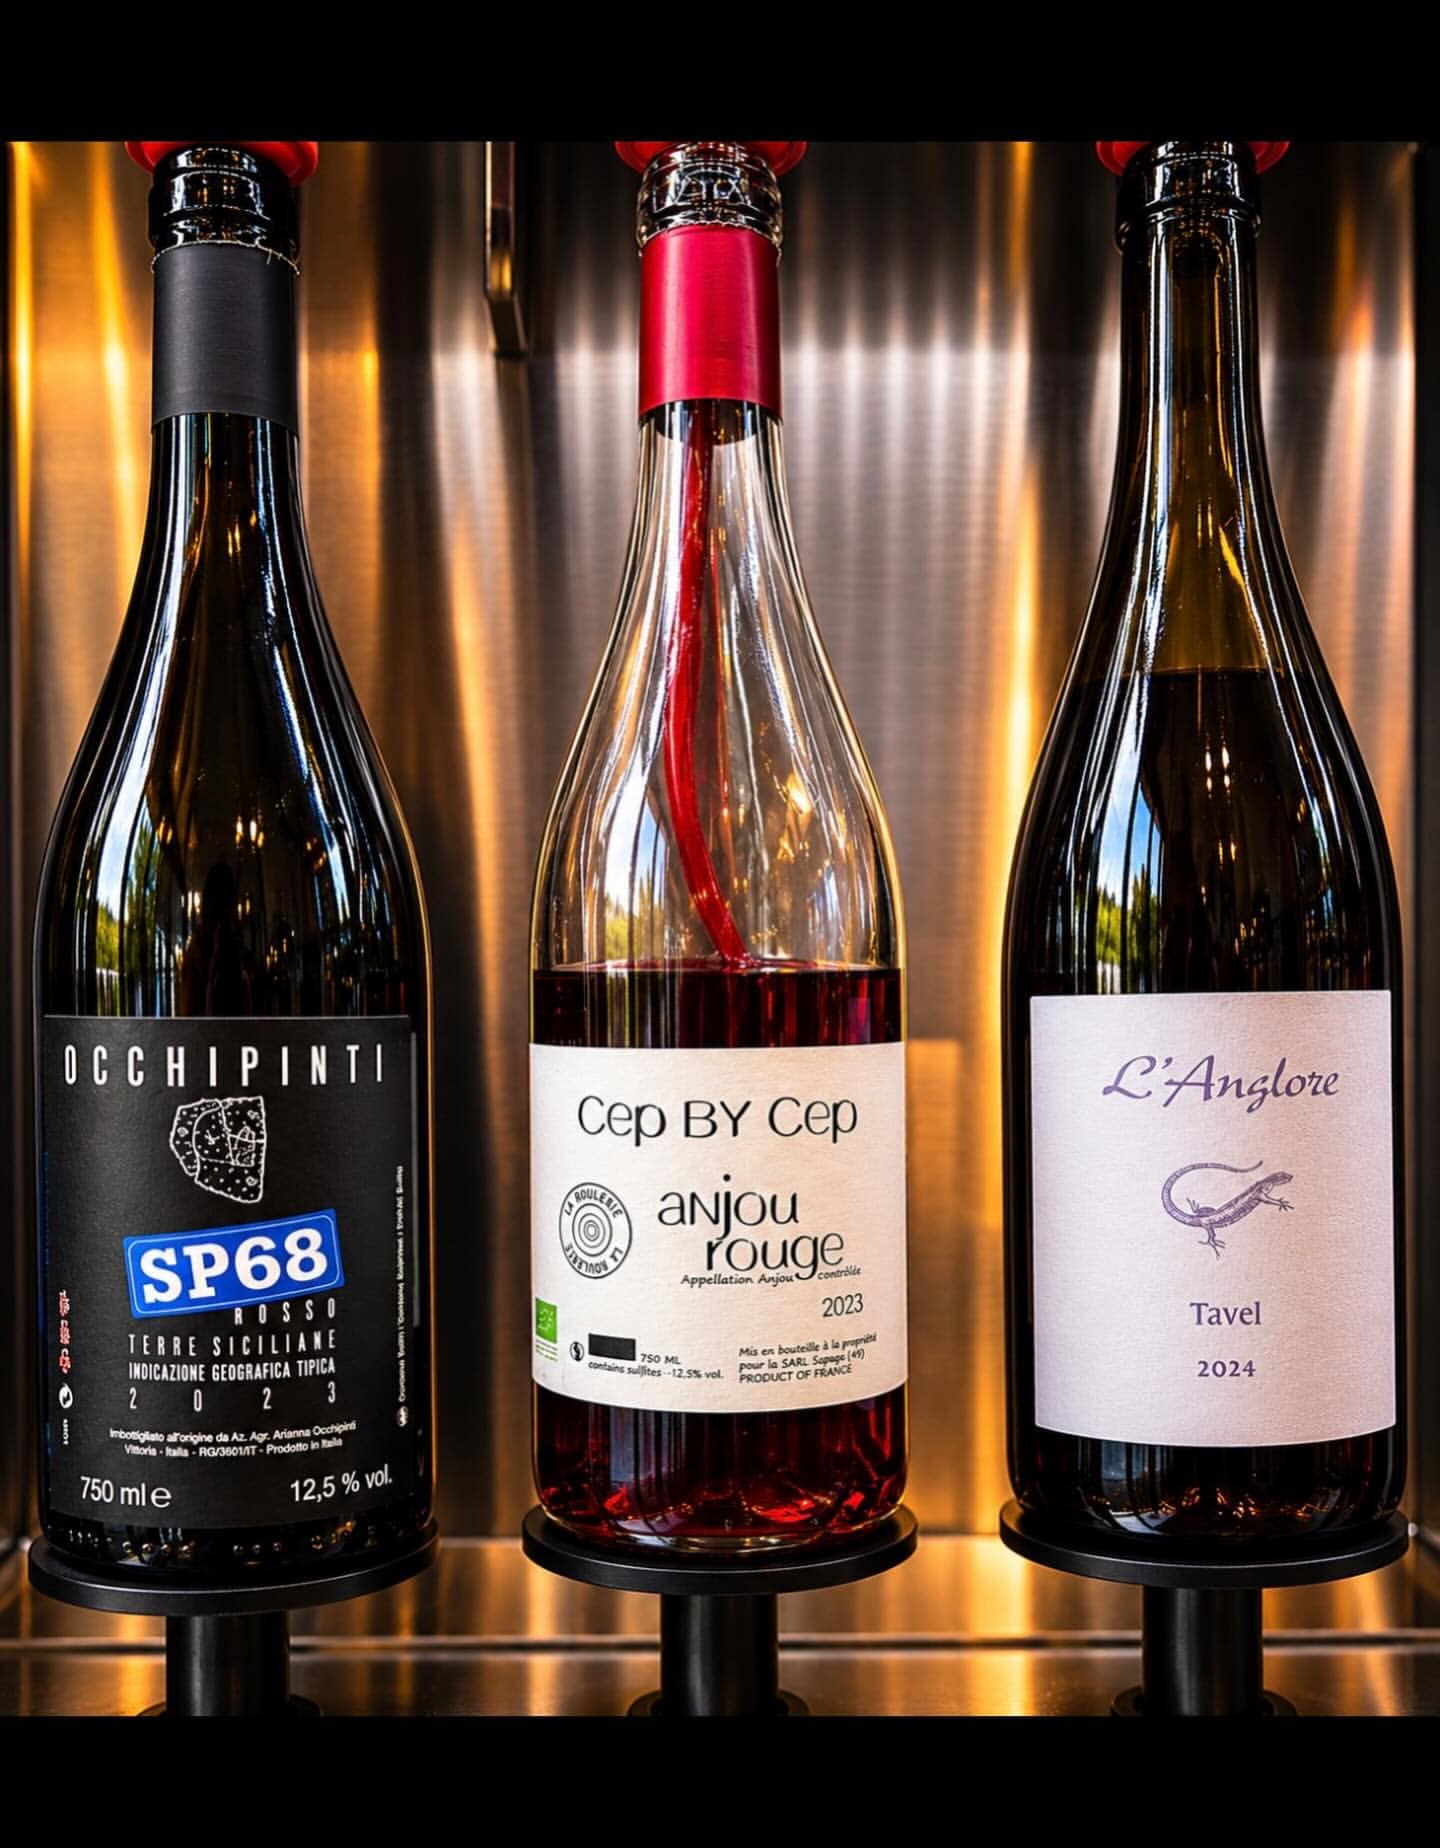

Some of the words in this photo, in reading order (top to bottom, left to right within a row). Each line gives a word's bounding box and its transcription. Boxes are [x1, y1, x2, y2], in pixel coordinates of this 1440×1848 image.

[64, 1043, 384, 1087] OCCHIPINTI
[1102, 1054, 1340, 1113] L'Anglore
[577, 1095, 667, 1147] Cep
[683, 1100, 752, 1138] BY
[768, 1096, 858, 1144] Cep
[564, 1200, 574, 1216] LA
[574, 1187, 623, 1218] ROULERIE
[139, 1228, 329, 1305] SP68
[706, 1232, 844, 1281] rouge
[680, 1273, 753, 1289] Appellation
[757, 1272, 795, 1288] Anjou
[234, 1297, 336, 1326] ROSSO
[822, 1292, 864, 1318] 2023
[1189, 1301, 1262, 1326] Tavel
[128, 1333, 197, 1357] TERRE
[212, 1329, 336, 1357] SICILIANE
[739, 1346, 758, 1357] Mis
[761, 1348, 775, 1356] en
[128, 1362, 206, 1382] INDICAZIONE
[212, 1361, 291, 1382] GEOGRAFICA
[296, 1356, 336, 1377] TIPICA
[588, 1361, 625, 1374] contains
[640, 1353, 661, 1364] 750
[664, 1354, 681, 1365] ML
[739, 1361, 765, 1373] pour
[768, 1359, 778, 1369] la
[781, 1357, 809, 1369] SARL
[1197, 1360, 1256, 1378] 2024
[739, 1371, 794, 1384] PRODUCT
[796, 1369, 811, 1380] OF
[814, 1363, 853, 1378] FRANCE
[216, 1432, 229, 1442] da
[231, 1432, 248, 1442] Az.
[249, 1431, 271, 1443] Agr.
[273, 1429, 311, 1440] Arianna
[312, 1420, 357, 1435] Occhipinti
[266, 1442, 309, 1455] Prodotto
[80, 1475, 114, 1503] 750
[290, 1474, 336, 1503] 12,5
[341, 1471, 360, 1495] %
[365, 1463, 393, 1489] vol.
